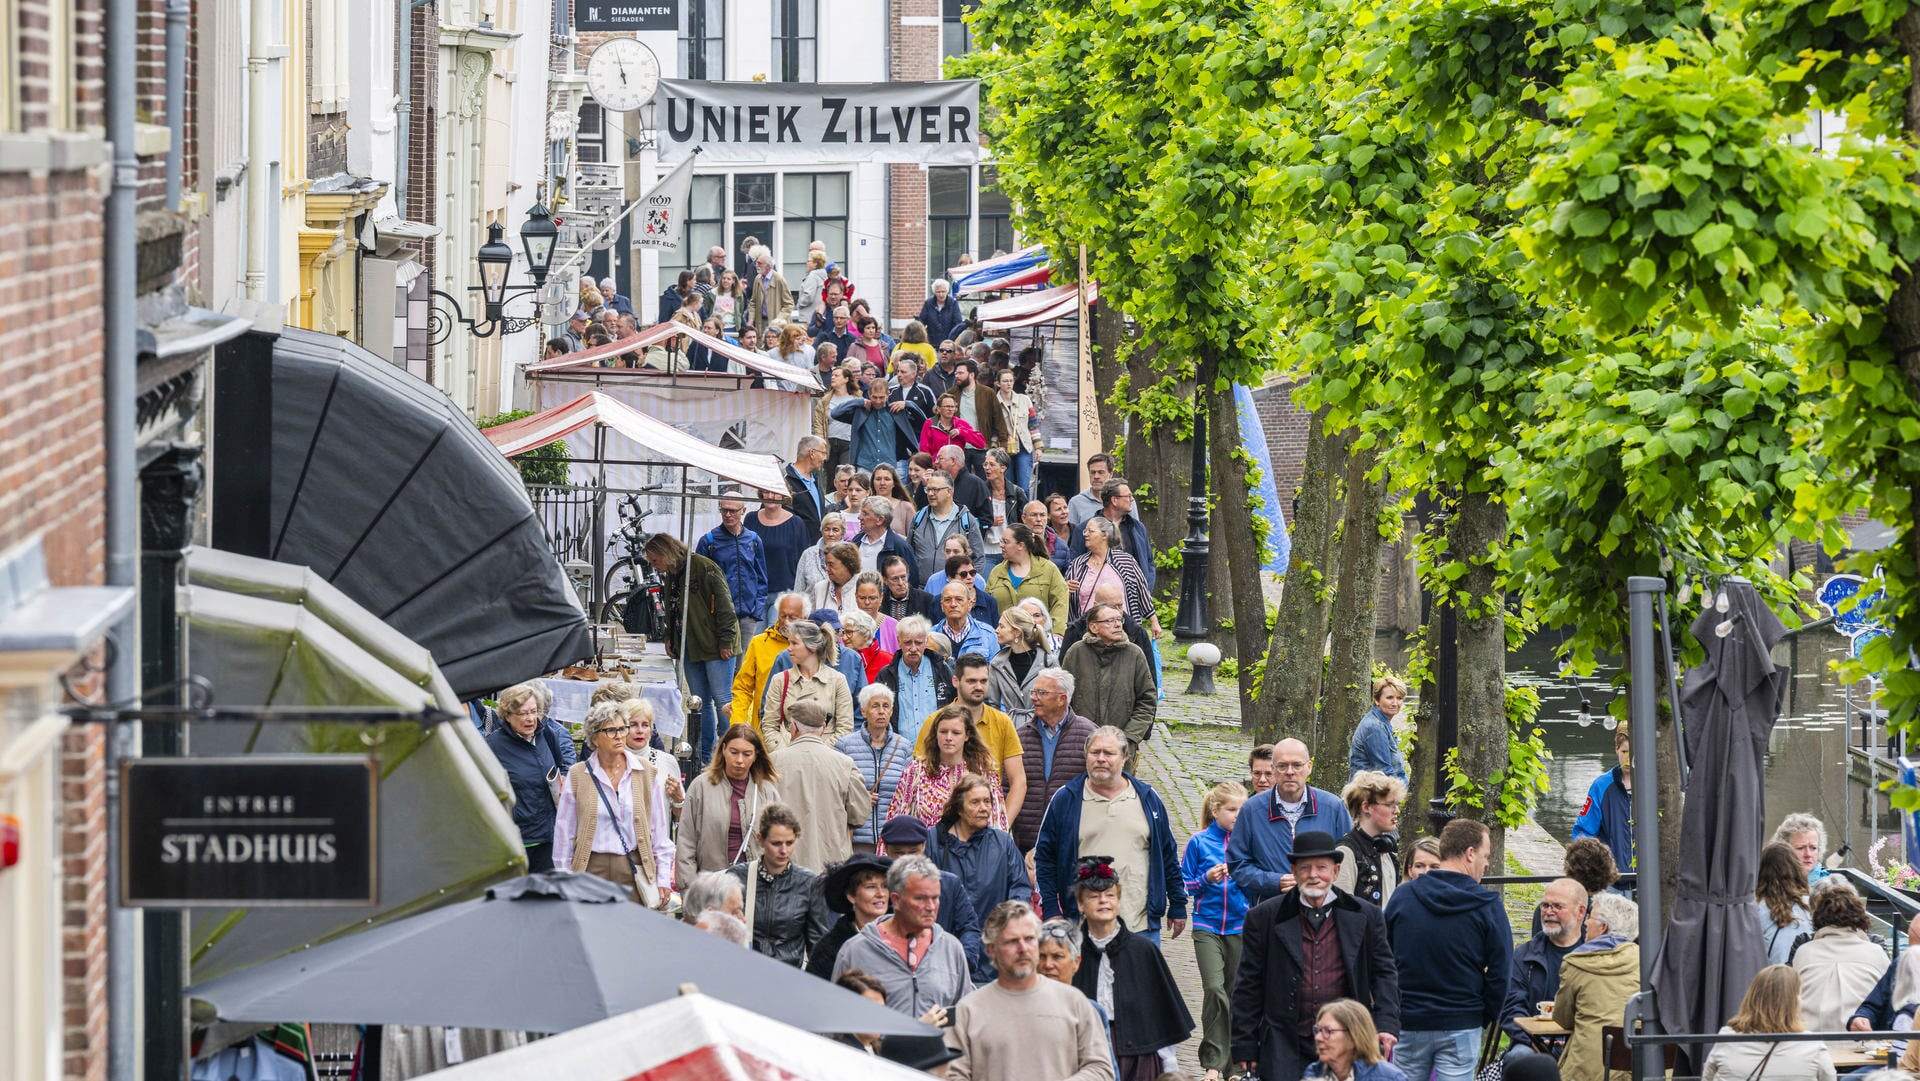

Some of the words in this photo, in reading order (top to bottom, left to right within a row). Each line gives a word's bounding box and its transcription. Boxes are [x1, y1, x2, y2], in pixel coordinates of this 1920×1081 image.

[611, 7, 671, 15] DIAMANTEN
[667, 97, 802, 144] UNIEK
[821, 97, 971, 144] ZILVER
[203, 796, 294, 813] ENTREE
[161, 834, 337, 864] STADHUIS
